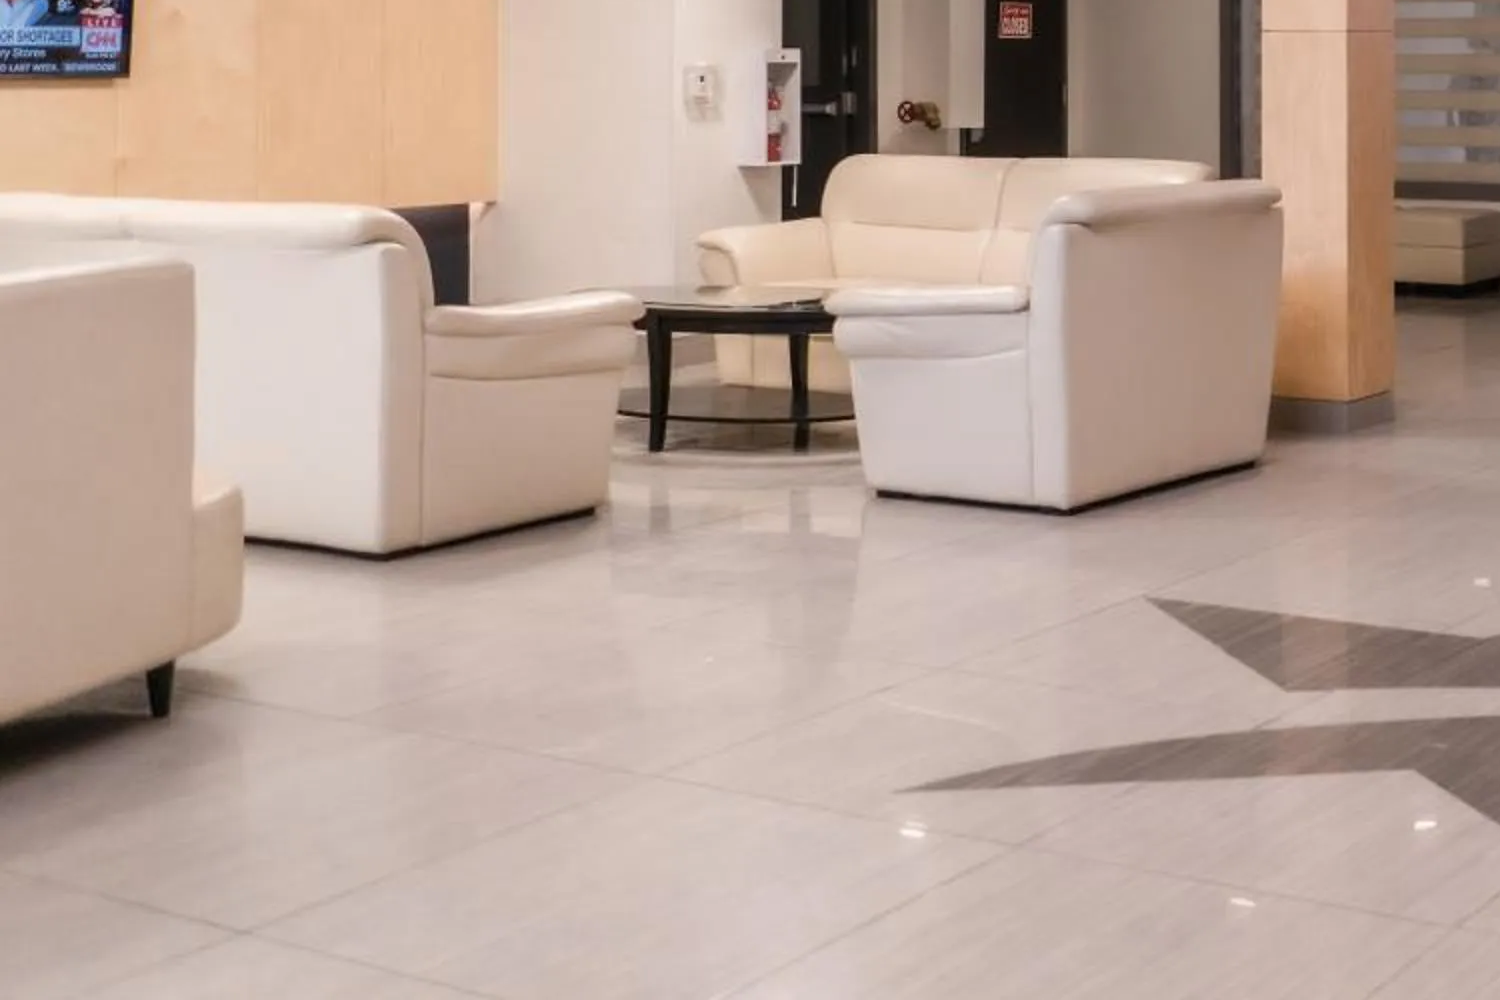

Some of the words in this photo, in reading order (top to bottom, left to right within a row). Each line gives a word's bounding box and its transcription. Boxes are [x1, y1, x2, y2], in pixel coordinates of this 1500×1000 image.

[1002, 17, 1029, 35] CLOSED
[17, 30, 73, 43] SHORTAGES
[12, 48, 46, 58] Stores
